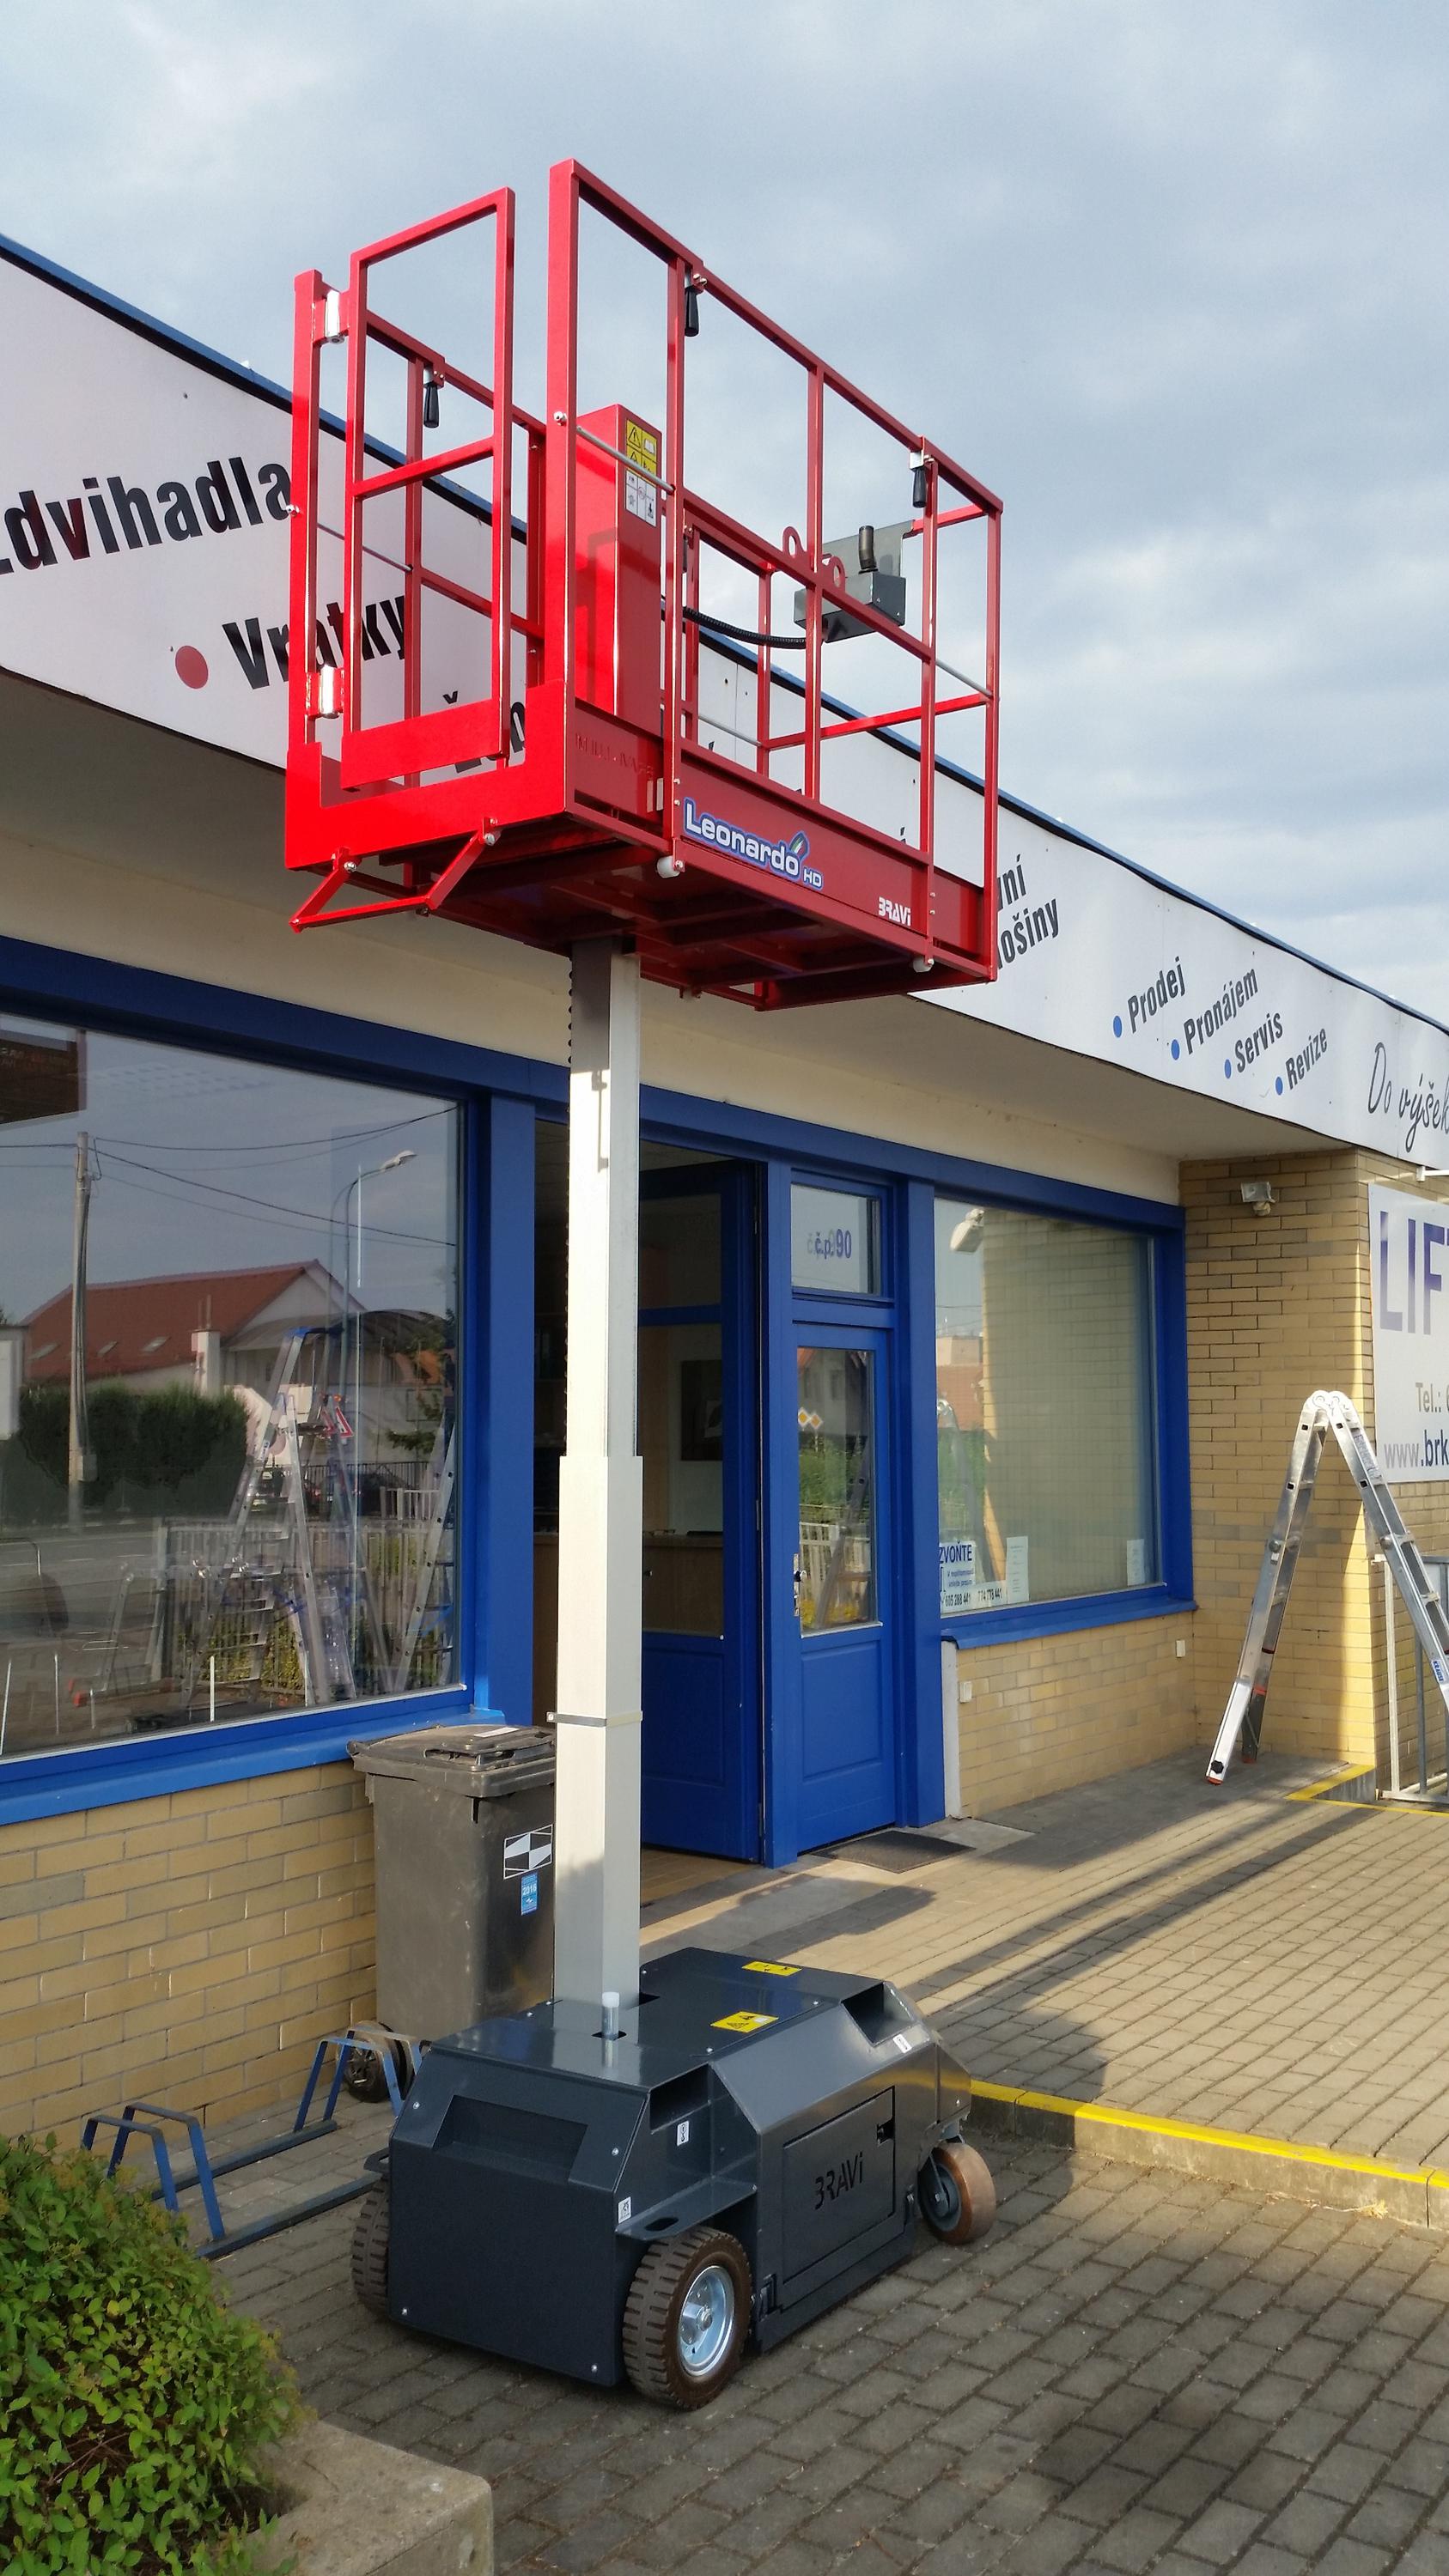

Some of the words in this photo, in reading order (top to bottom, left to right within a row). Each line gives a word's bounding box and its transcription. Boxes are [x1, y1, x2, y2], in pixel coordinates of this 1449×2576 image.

[0, 457, 291, 575] dvihadla
[685, 800, 801, 877] Leonardo
[803, 868, 823, 888] HD
[1128, 956, 1185, 1034] Prodej
[1184, 969, 1258, 1054] Pronájem
[1234, 1012, 1283, 1073] Servis
[1285, 1028, 1328, 1091] Revize
[1367, 1042, 1392, 1114] Do
[1379, 1211, 1449, 1335] LIF
[1415, 1382, 1441, 1413] Tel.:
